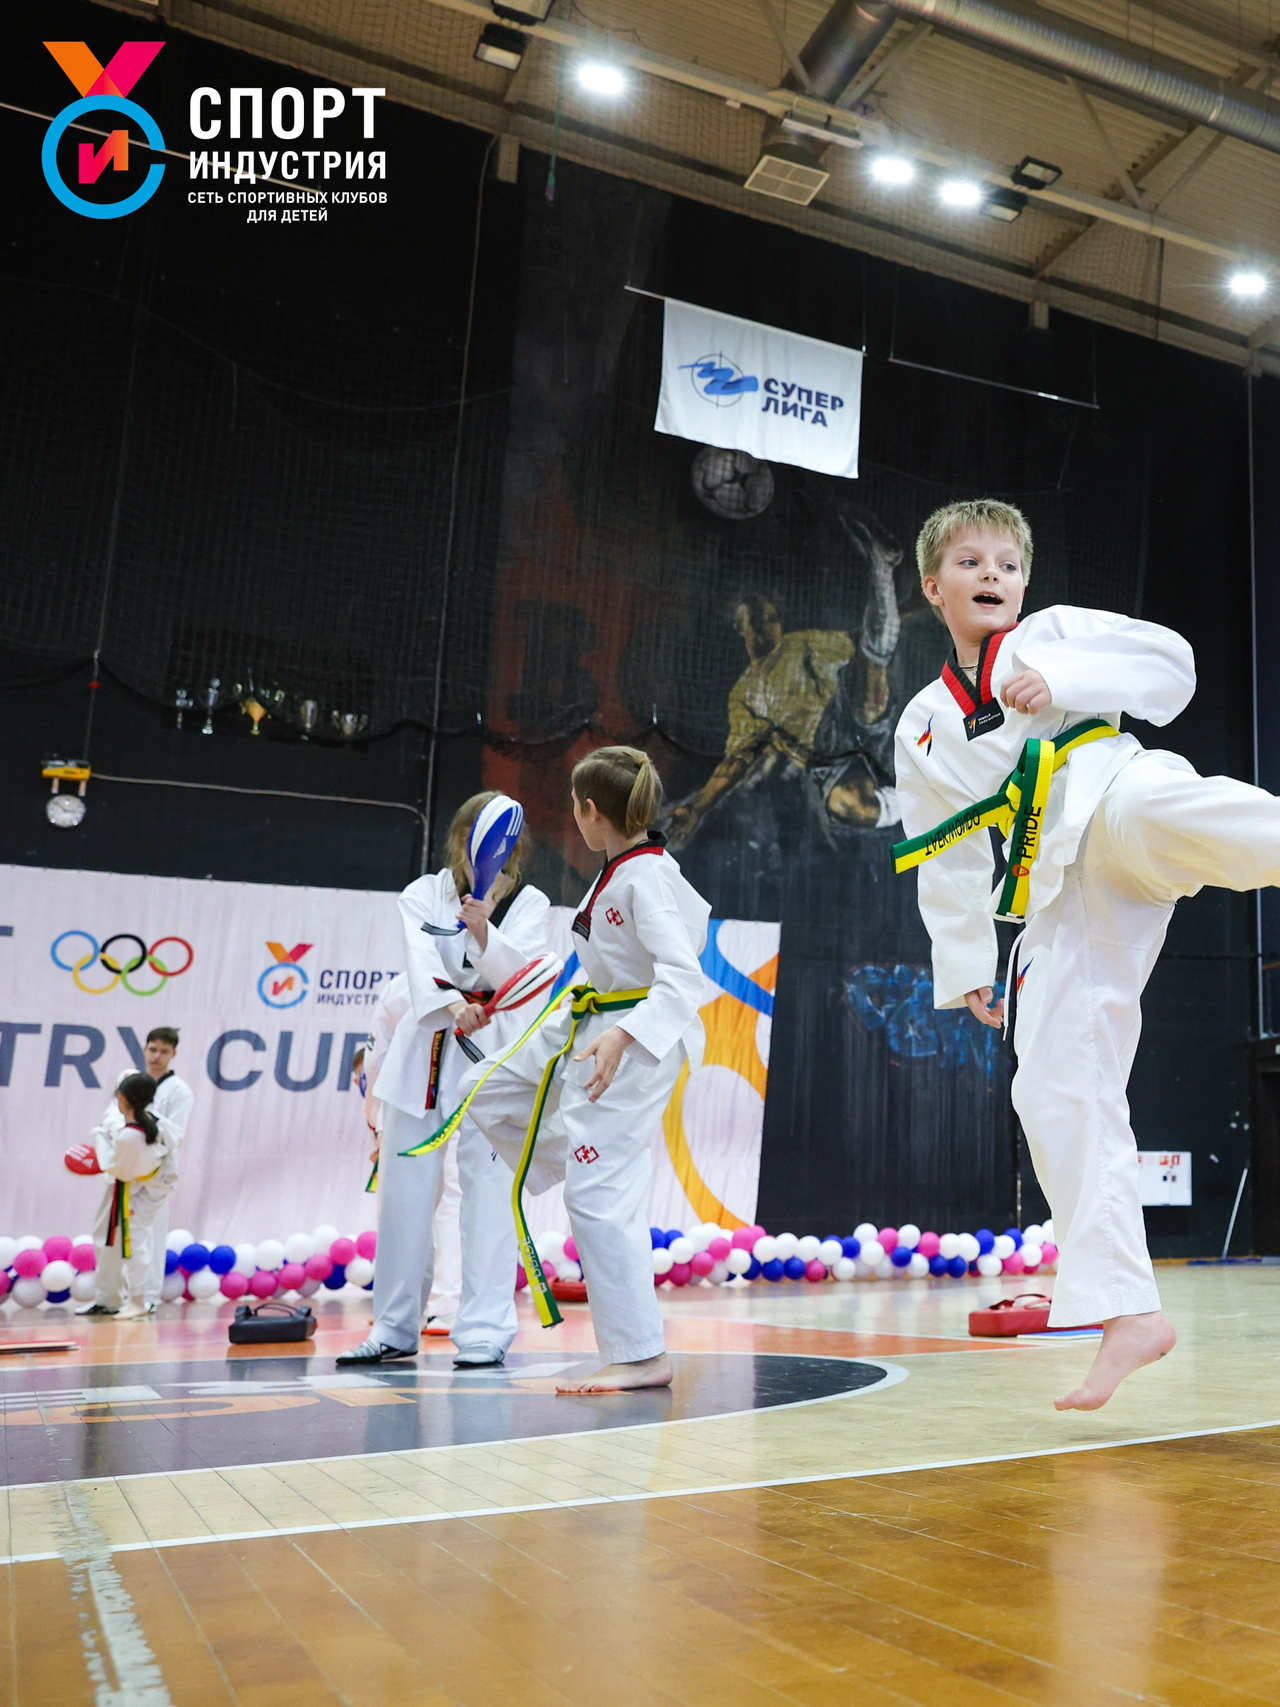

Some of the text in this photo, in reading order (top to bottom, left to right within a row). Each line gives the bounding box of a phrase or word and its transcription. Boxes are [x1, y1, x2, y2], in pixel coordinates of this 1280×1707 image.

[763, 378, 844, 411] СУПЕР
[761, 397, 828, 427] ЛИГА
[1016, 806, 1042, 859] PRIDE
[317, 993, 380, 1006] ИНДУСТР
